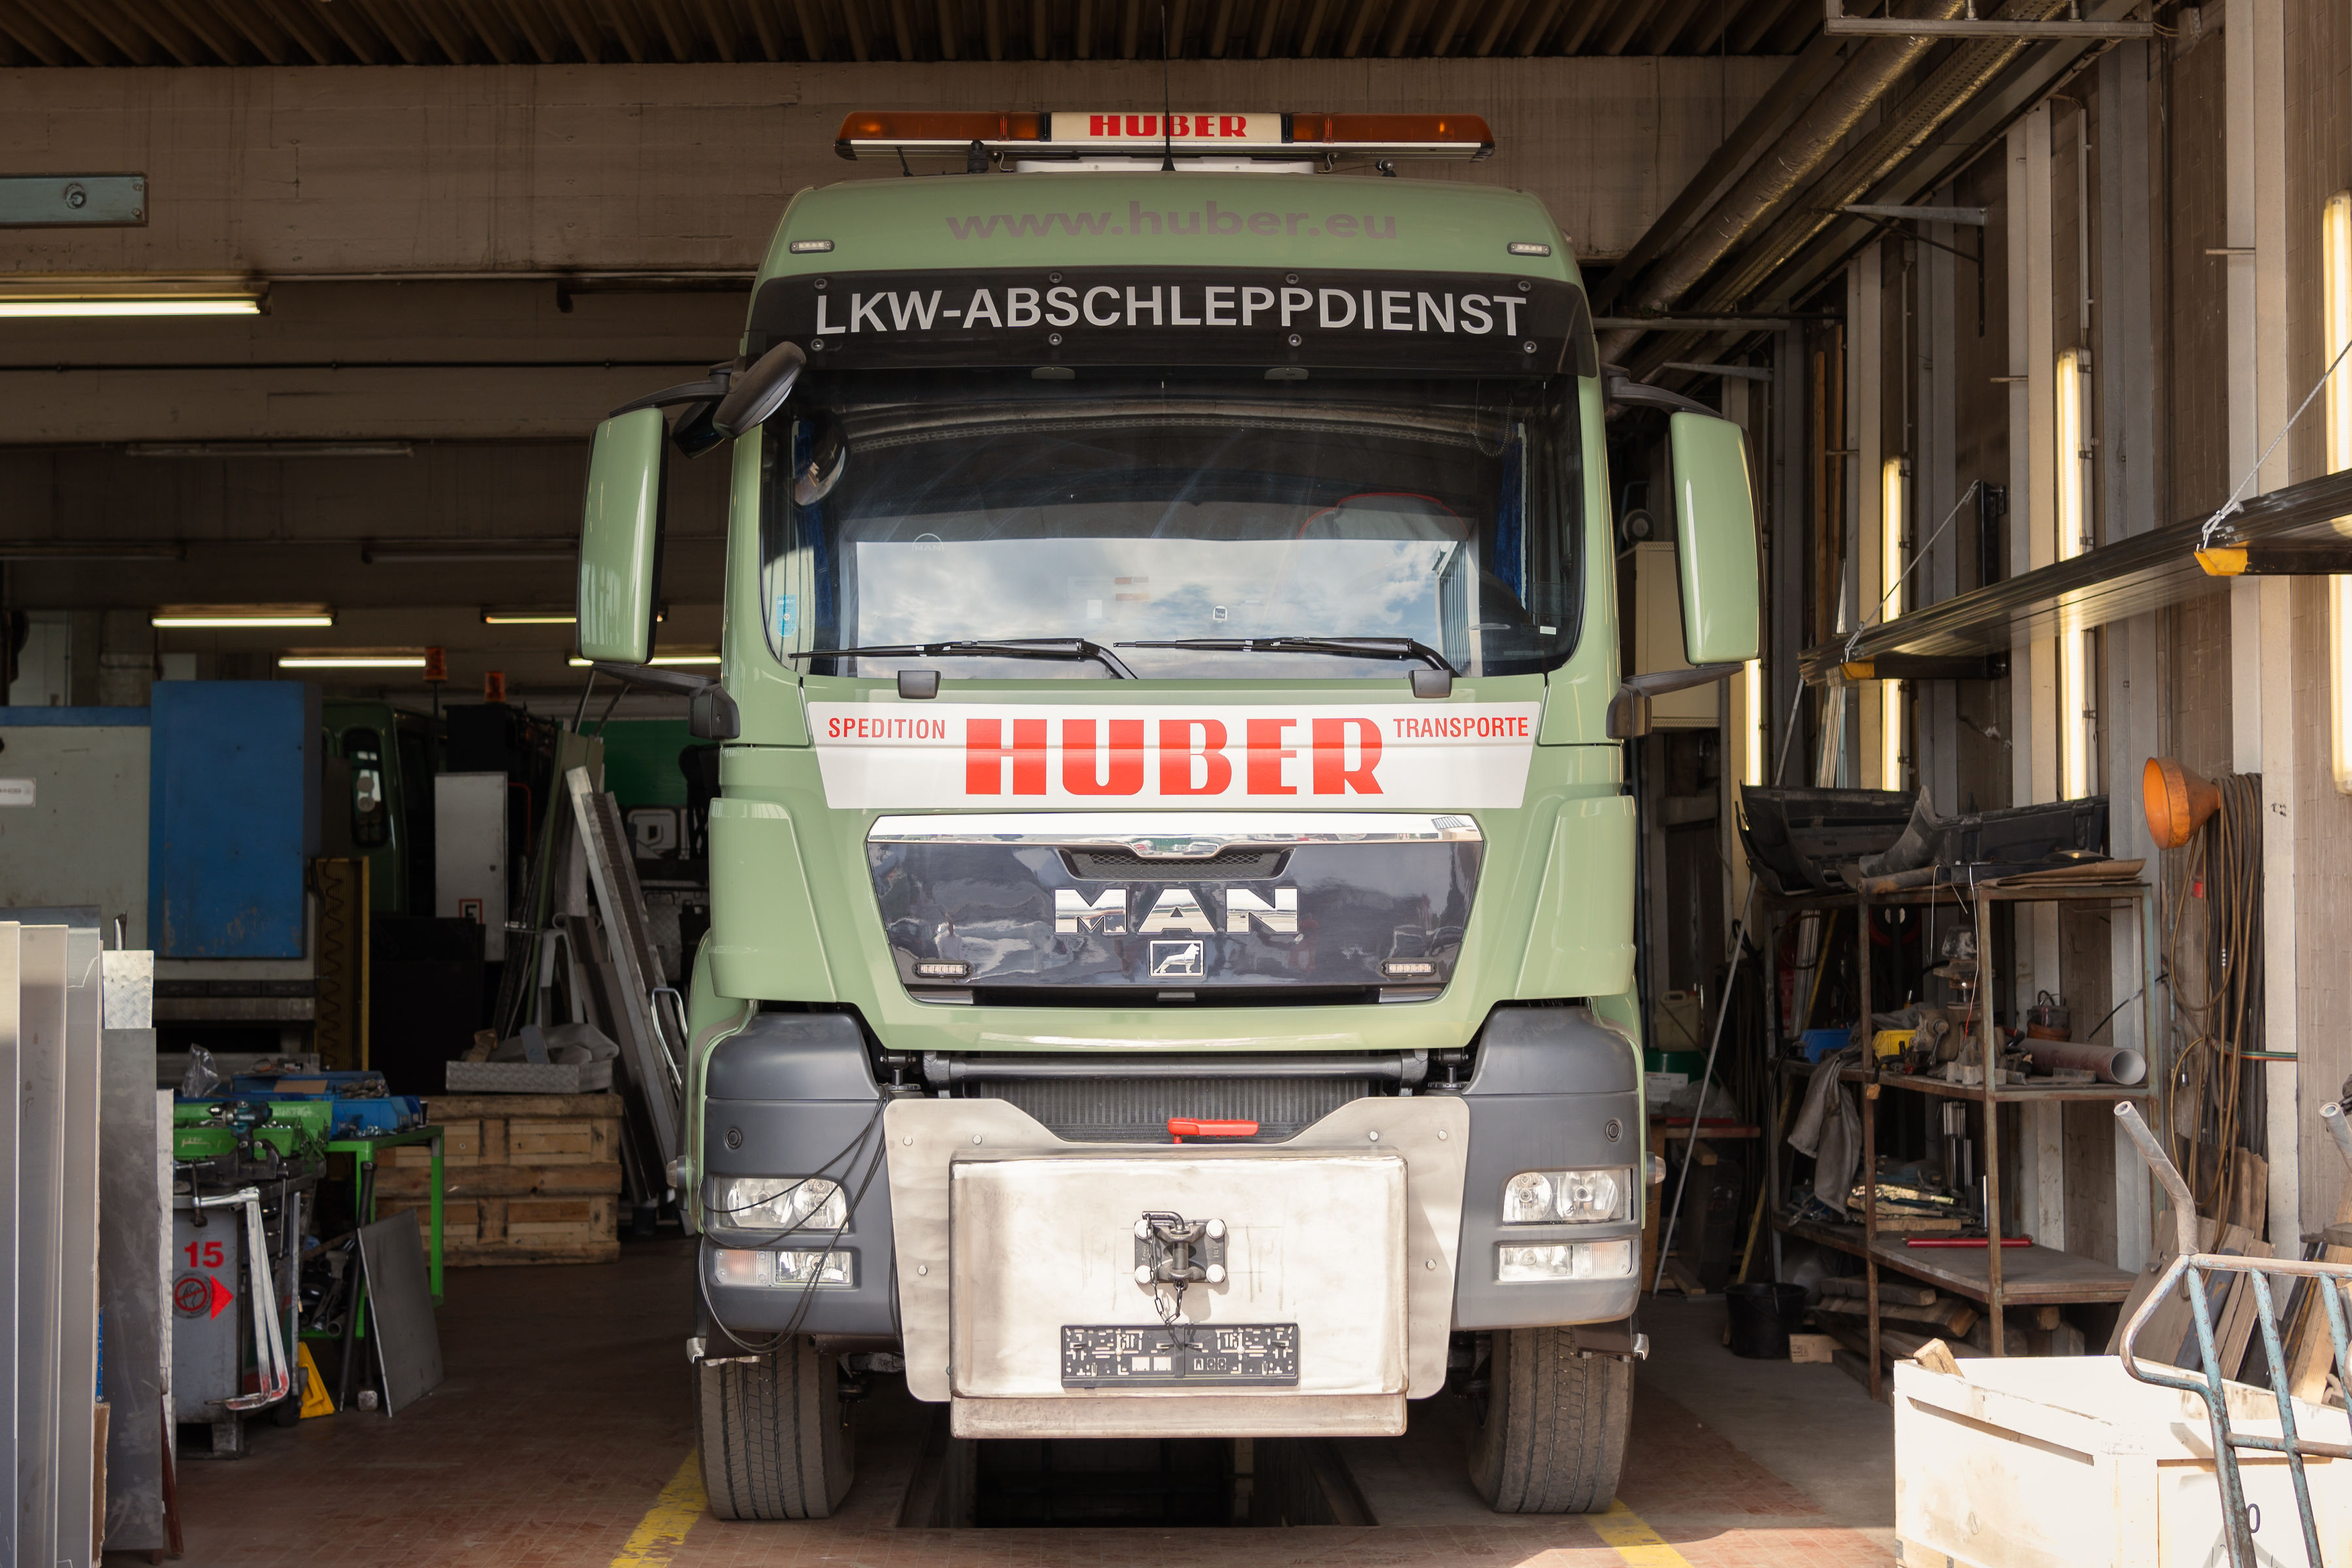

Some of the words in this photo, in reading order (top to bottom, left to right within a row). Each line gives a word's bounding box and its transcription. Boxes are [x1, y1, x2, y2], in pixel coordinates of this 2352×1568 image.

[1089, 114, 1247, 137] HUBER
[945, 200, 1397, 240] www.huber.eu
[817, 286, 1527, 336] LKW-ABSCHLEPPDIENST
[828, 717, 945, 739] SPEDITION
[1393, 717, 1529, 738] TRANSPORTE
[966, 717, 1384, 796] HUBER
[1054, 889, 1299, 934] MAN
[184, 1241, 225, 1268] 15
